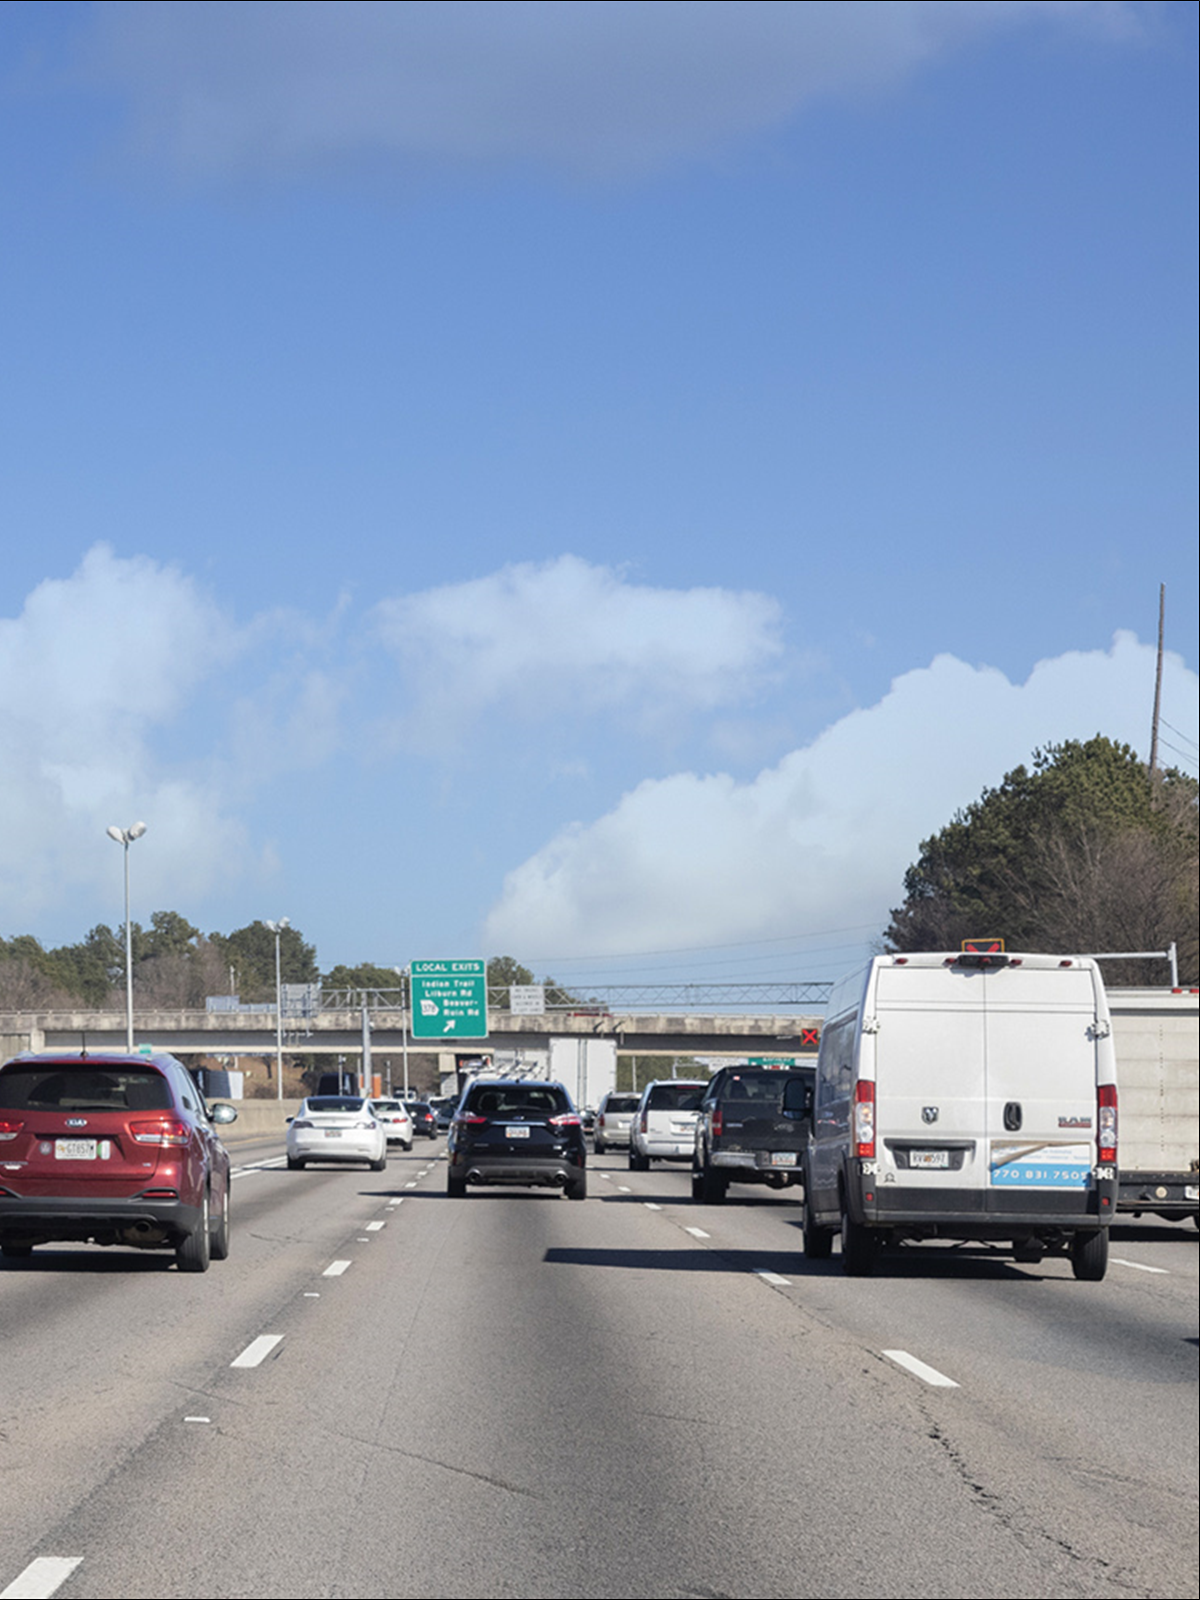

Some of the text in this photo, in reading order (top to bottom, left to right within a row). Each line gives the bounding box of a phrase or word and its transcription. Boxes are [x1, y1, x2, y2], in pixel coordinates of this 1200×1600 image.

[416, 963, 480, 972] LOCAL EXITS
[422, 980, 475, 988] Indian Trail
[425, 989, 472, 997] Lilburn Rd
[467, 1008, 479, 1016] Rd
